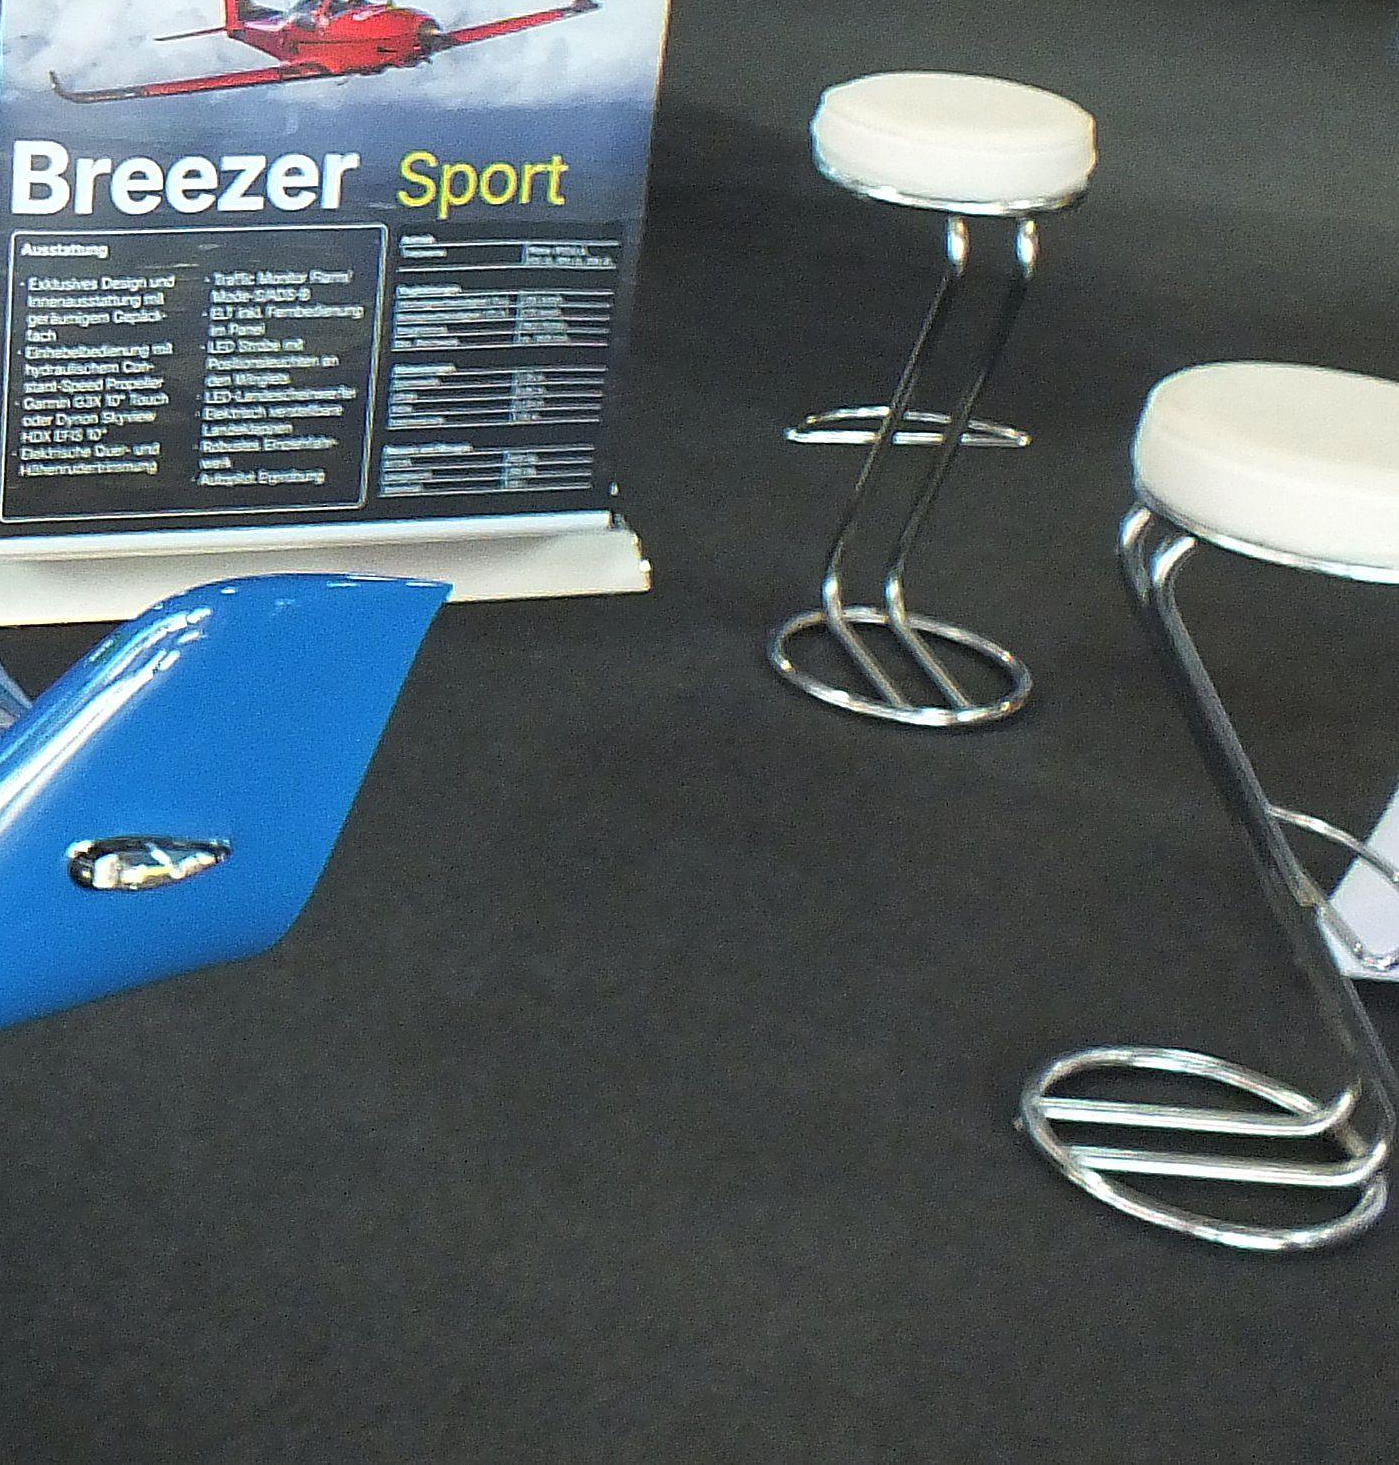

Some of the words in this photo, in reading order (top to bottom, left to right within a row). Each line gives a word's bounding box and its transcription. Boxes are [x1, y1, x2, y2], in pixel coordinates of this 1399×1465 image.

[11, 139, 360, 216] Breezer
[396, 150, 569, 220] Sport
[101, 277, 147, 291] Design
[150, 275, 175, 288] und
[207, 340, 236, 353] LED
